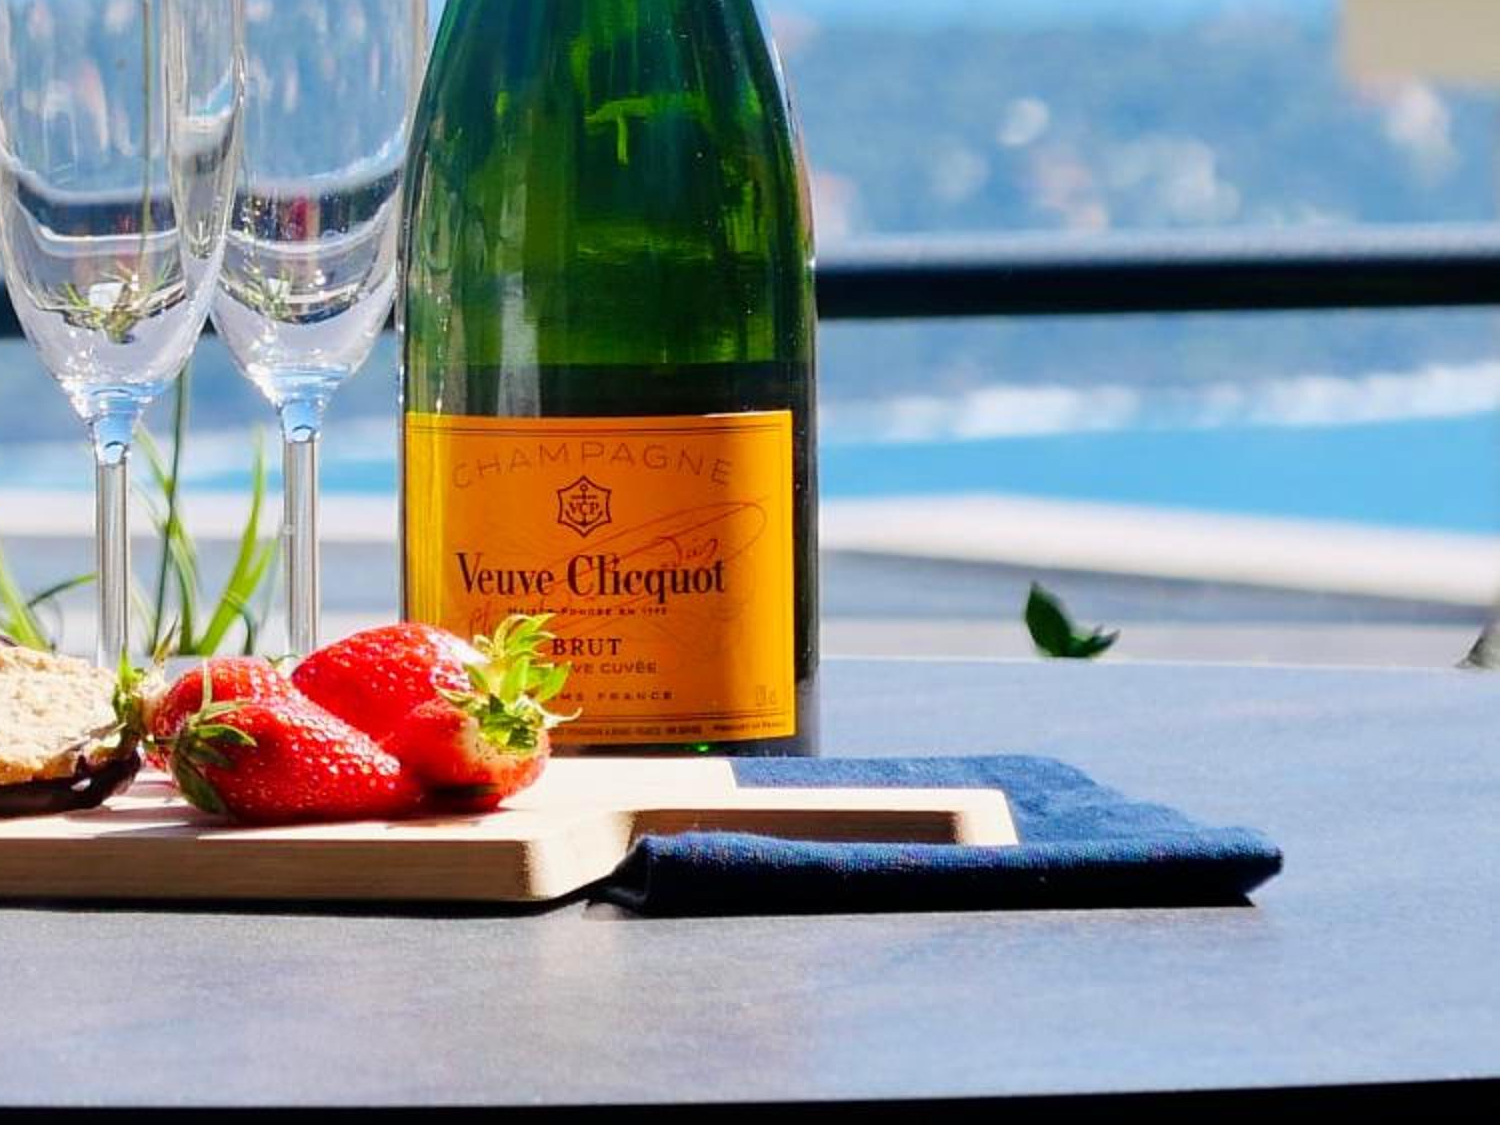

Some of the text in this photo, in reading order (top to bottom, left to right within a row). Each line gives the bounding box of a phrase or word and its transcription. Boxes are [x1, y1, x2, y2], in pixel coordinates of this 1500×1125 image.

[452, 441, 733, 489] CHAMPAGNE
[456, 552, 725, 604] Veuve Clicquot
[552, 638, 622, 656] BRUT
[601, 660, 657, 674] CUVÉE
